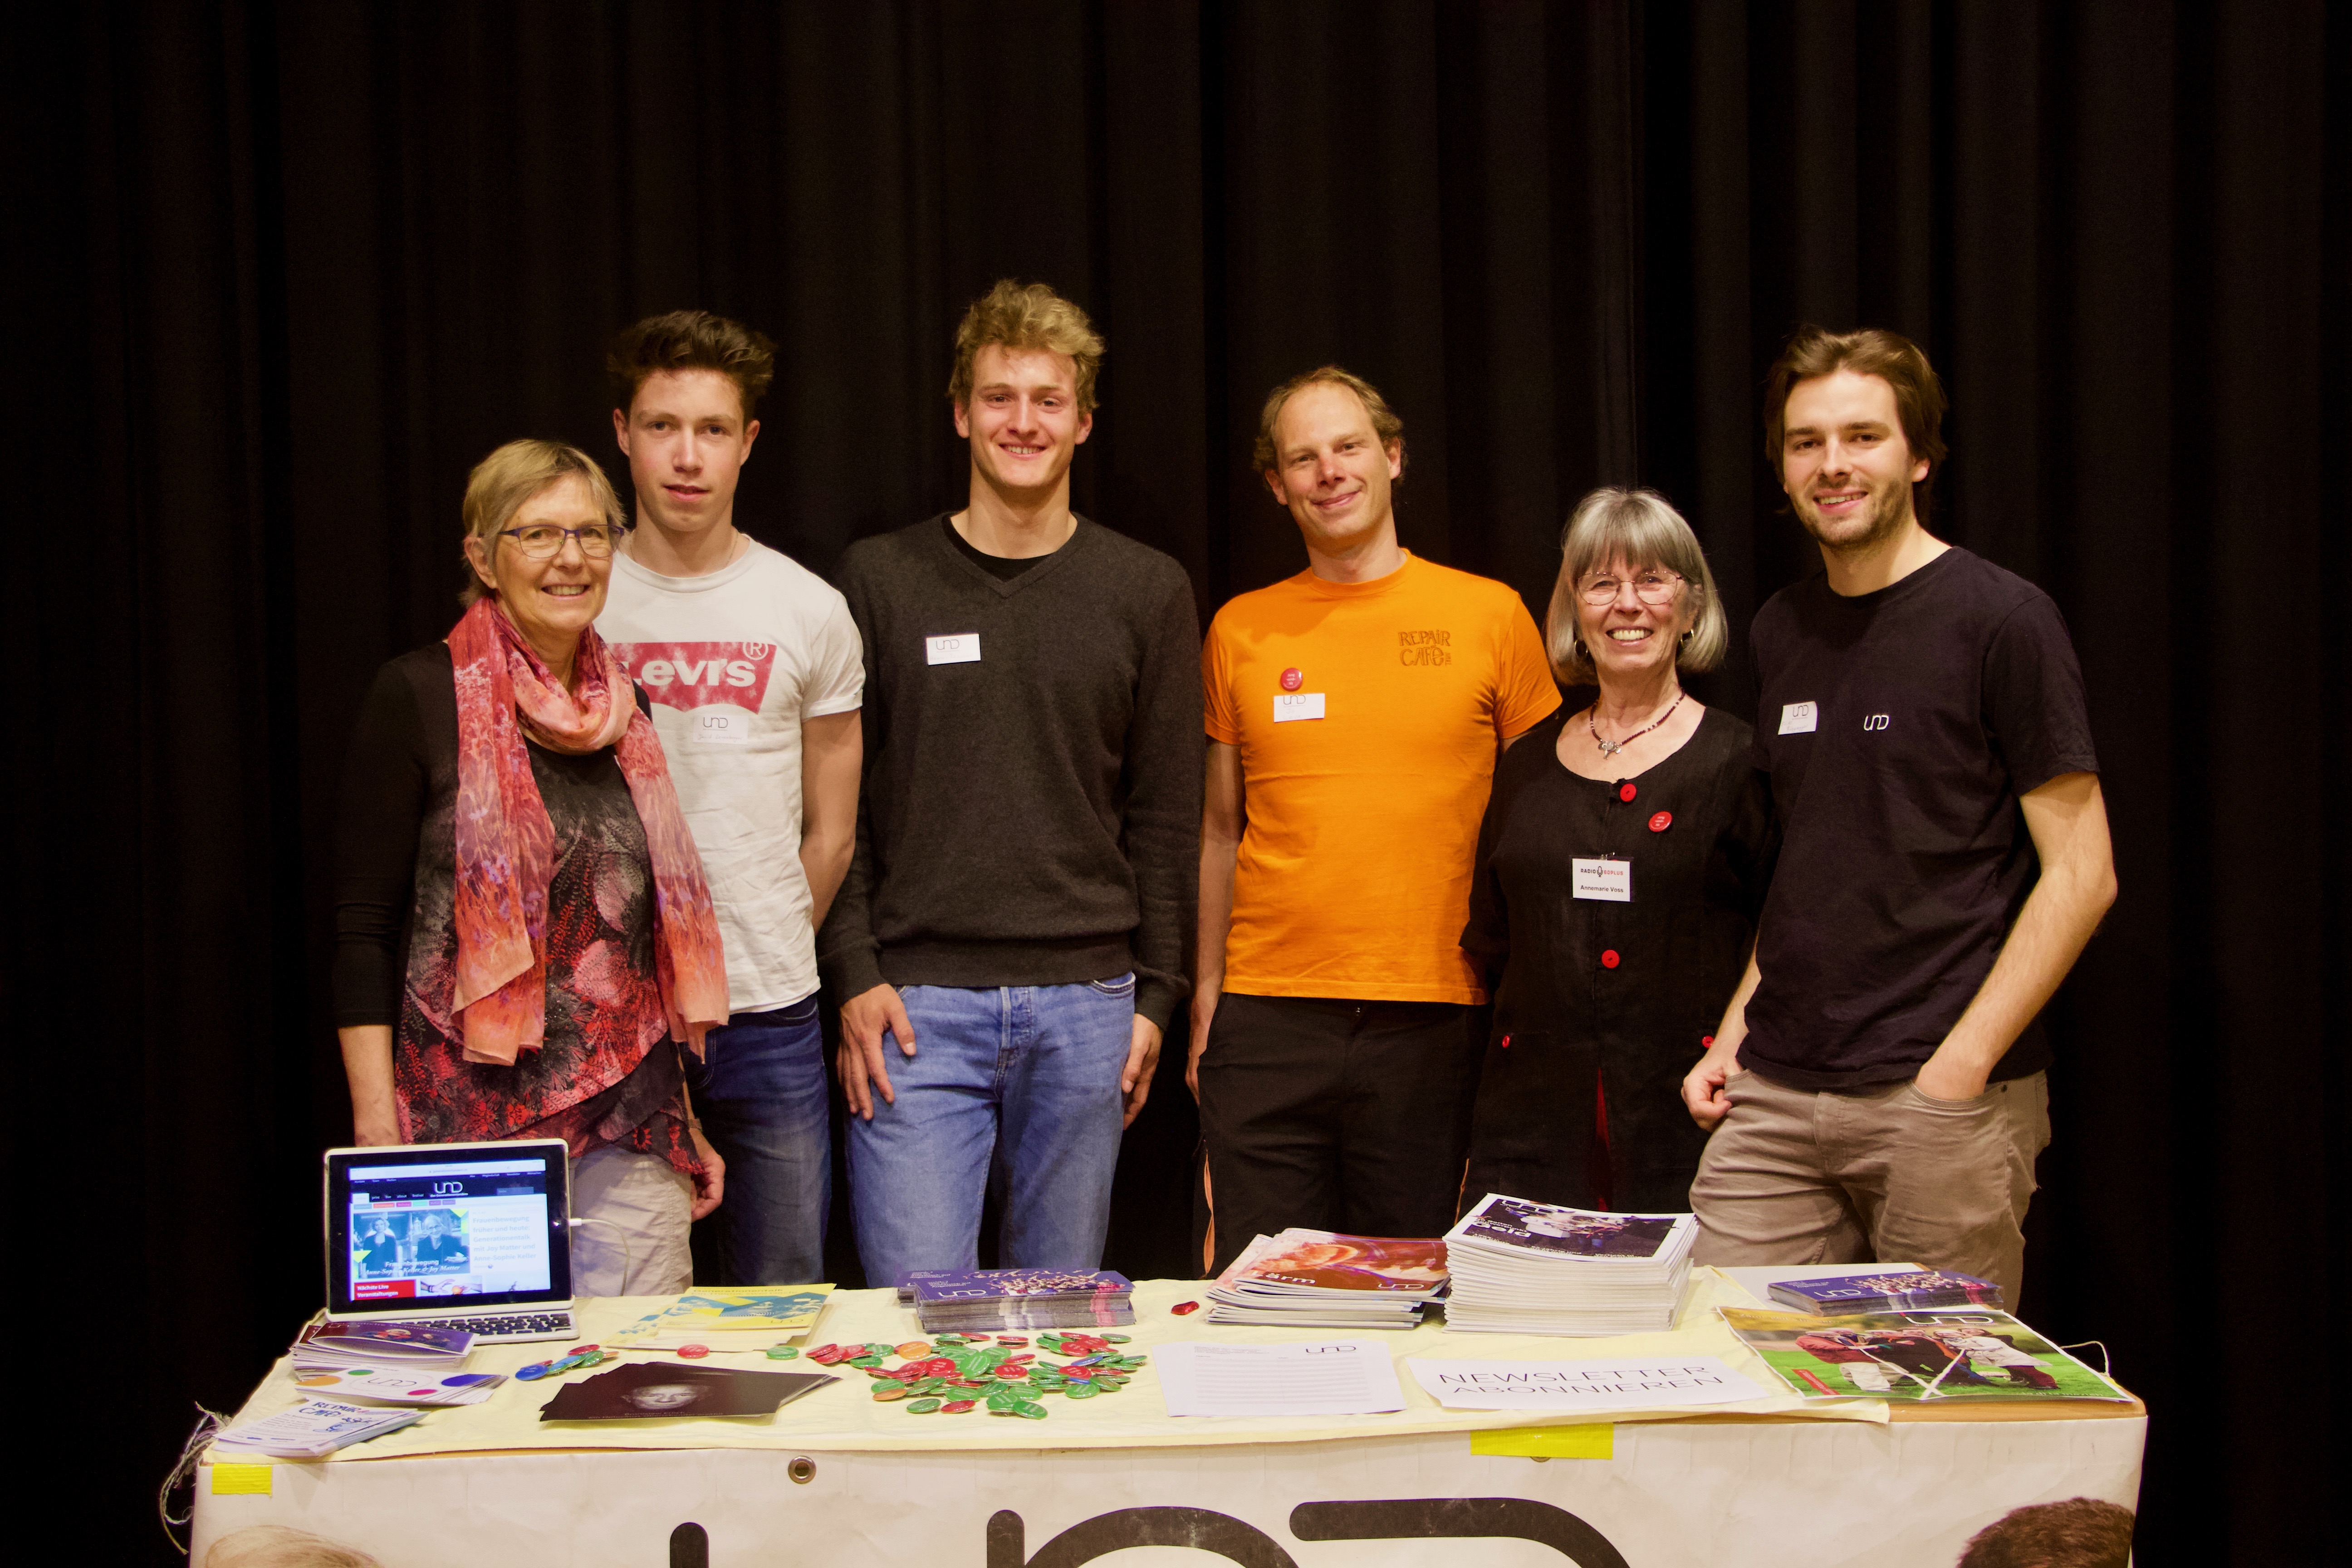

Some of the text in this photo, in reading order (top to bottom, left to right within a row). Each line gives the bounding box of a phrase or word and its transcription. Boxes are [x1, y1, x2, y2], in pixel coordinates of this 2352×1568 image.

[473, 1234, 531, 1242] Generationentalk
[385, 1259, 440, 1268] Frauenbewegung
[1251, 1270, 1316, 1284] Lärm
[1439, 1367, 1711, 1383] NEWSLETTER
[1452, 1376, 1724, 1394] ABONNIEREN
